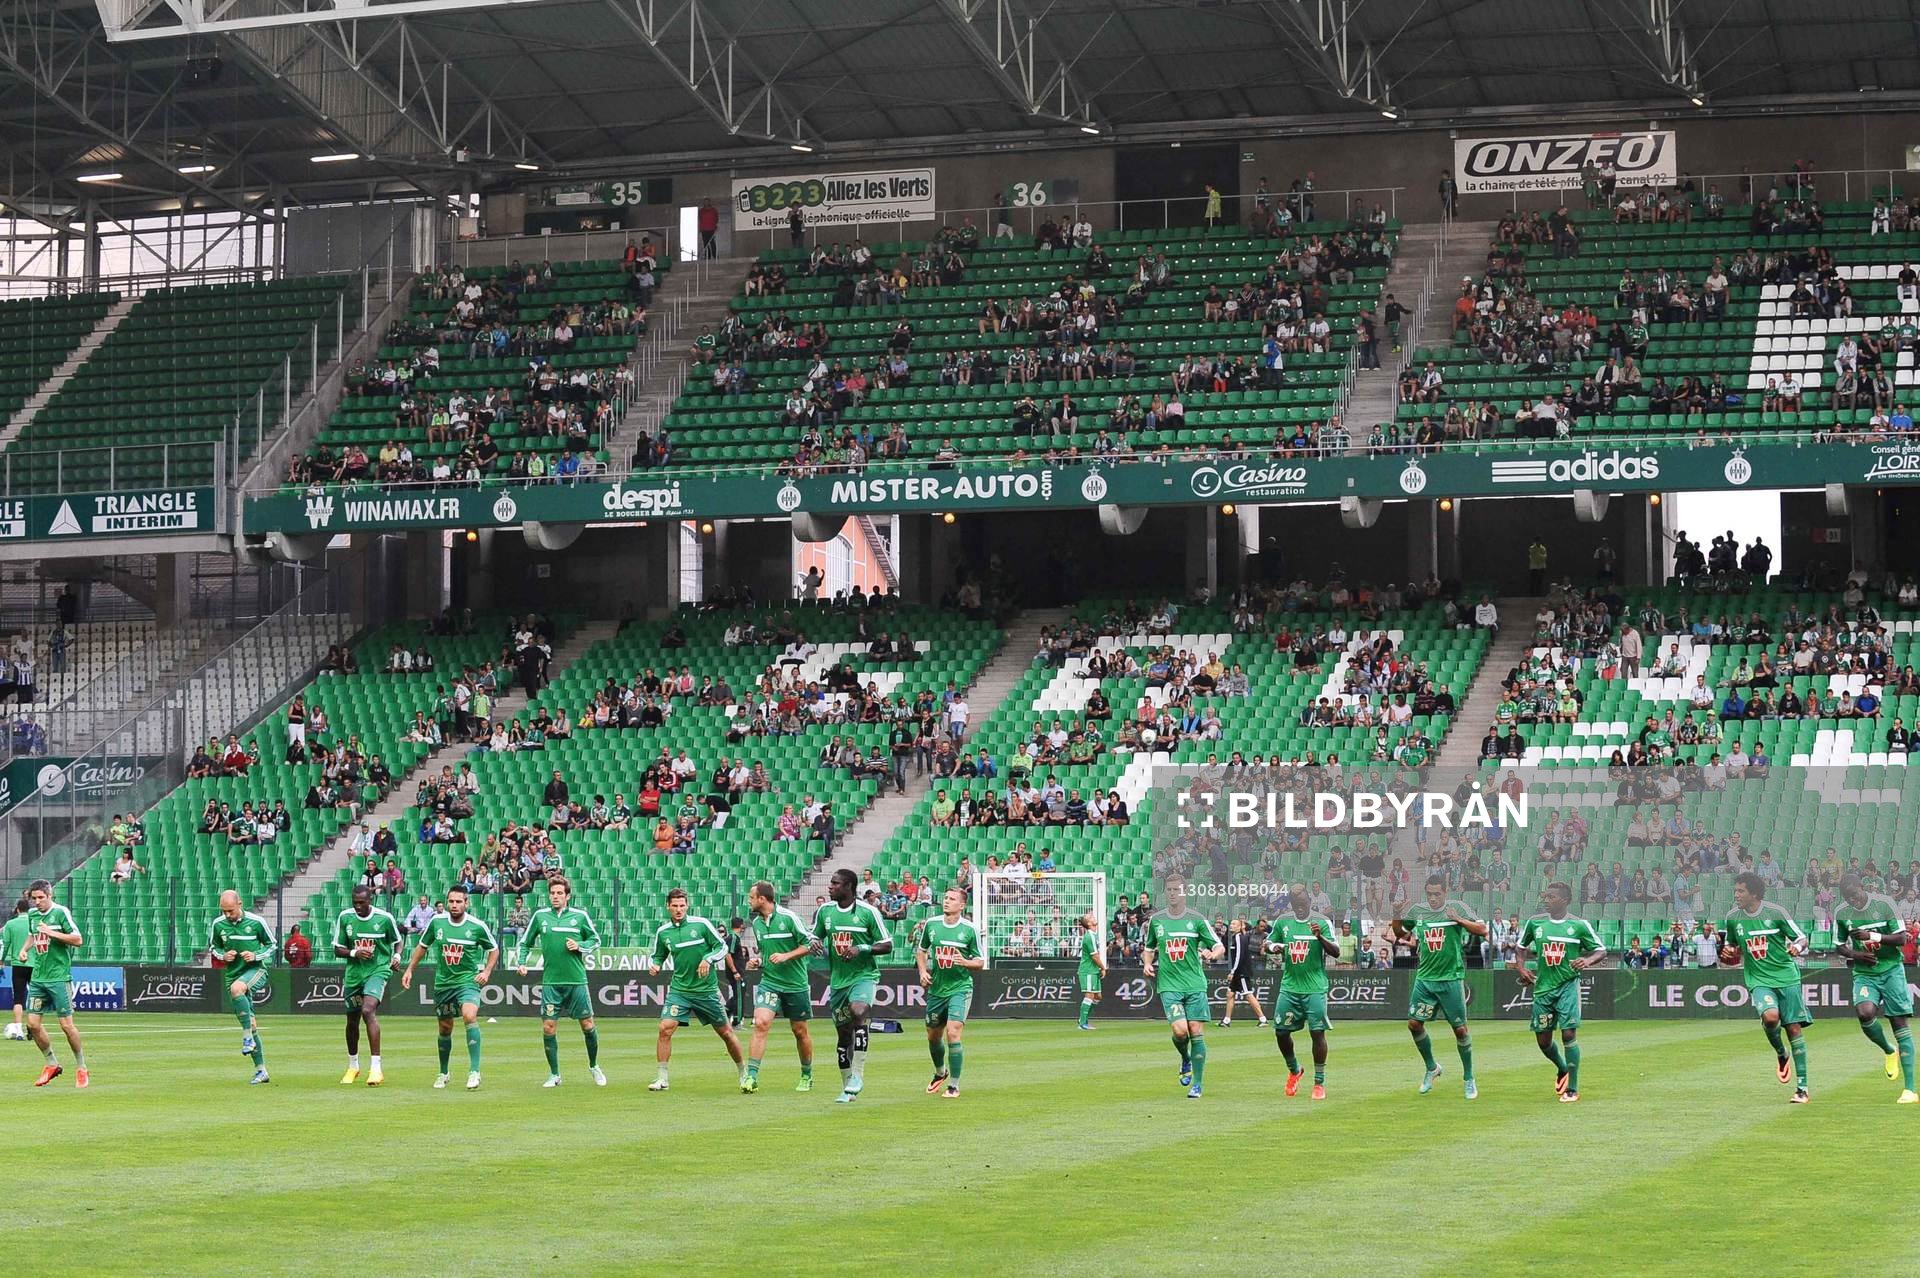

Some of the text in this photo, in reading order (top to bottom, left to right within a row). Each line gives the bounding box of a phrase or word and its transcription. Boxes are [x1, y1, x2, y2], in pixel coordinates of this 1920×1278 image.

[1472, 136, 1653, 173] ONZEO
[1466, 180, 1477, 191] la
[1518, 178, 1532, 189] de
[1620, 172, 1650, 185] canal
[611, 181, 642, 206] 35
[754, 184, 820, 208] 3223
[827, 181, 862, 201] Allez
[863, 179, 887, 199] les
[888, 177, 929, 197] Verts
[1012, 182, 1047, 206] 36
[752, 216, 766, 227] la
[864, 208, 911, 220] officielle
[1870, 445, 1900, 454] Conseil
[1549, 450, 1660, 482] adidas
[1877, 455, 1920, 470] LOIR
[831, 473, 1038, 503] MISTER-AUTO
[1245, 486, 1305, 496] restauration
[94, 491, 197, 515] TRIANGLE
[603, 480, 682, 516] despi
[344, 497, 460, 522] WINAMAX.FR
[106, 514, 183, 530] INTERIM
[71, 979, 117, 999] yaux
[142, 974, 206, 985] Conseil général
[147, 982, 204, 996] LOIRE
[308, 975, 340, 984] Conseil
[1001, 975, 1076, 986] Conseil général
[1115, 978, 1147, 1000] 42
[1352, 976, 1390, 987] général
[1005, 985, 1073, 1000] LOIRE
[1649, 985, 1685, 1007] LE
[1284, 1011, 1294, 1026] 2
